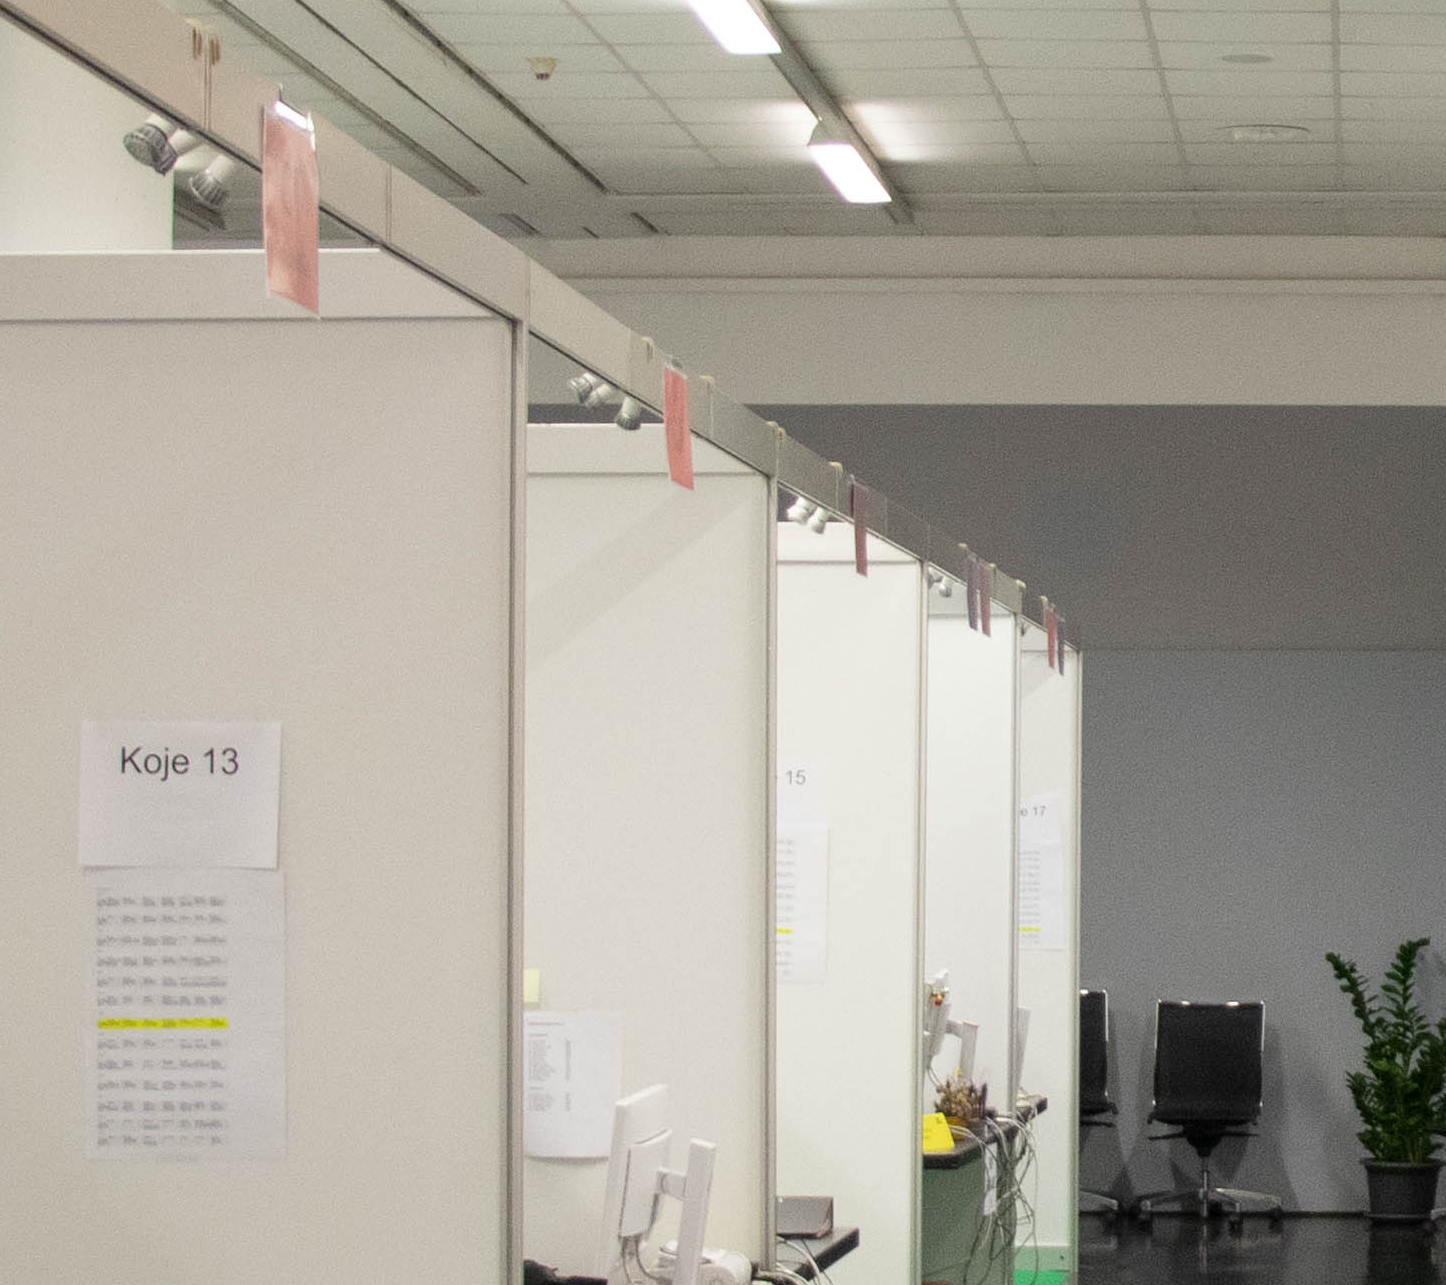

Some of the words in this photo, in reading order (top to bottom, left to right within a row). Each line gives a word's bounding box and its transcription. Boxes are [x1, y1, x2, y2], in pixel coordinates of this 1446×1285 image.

[119, 747, 190, 781] Koje
[203, 747, 240, 776] 13
[785, 770, 807, 786] 15
